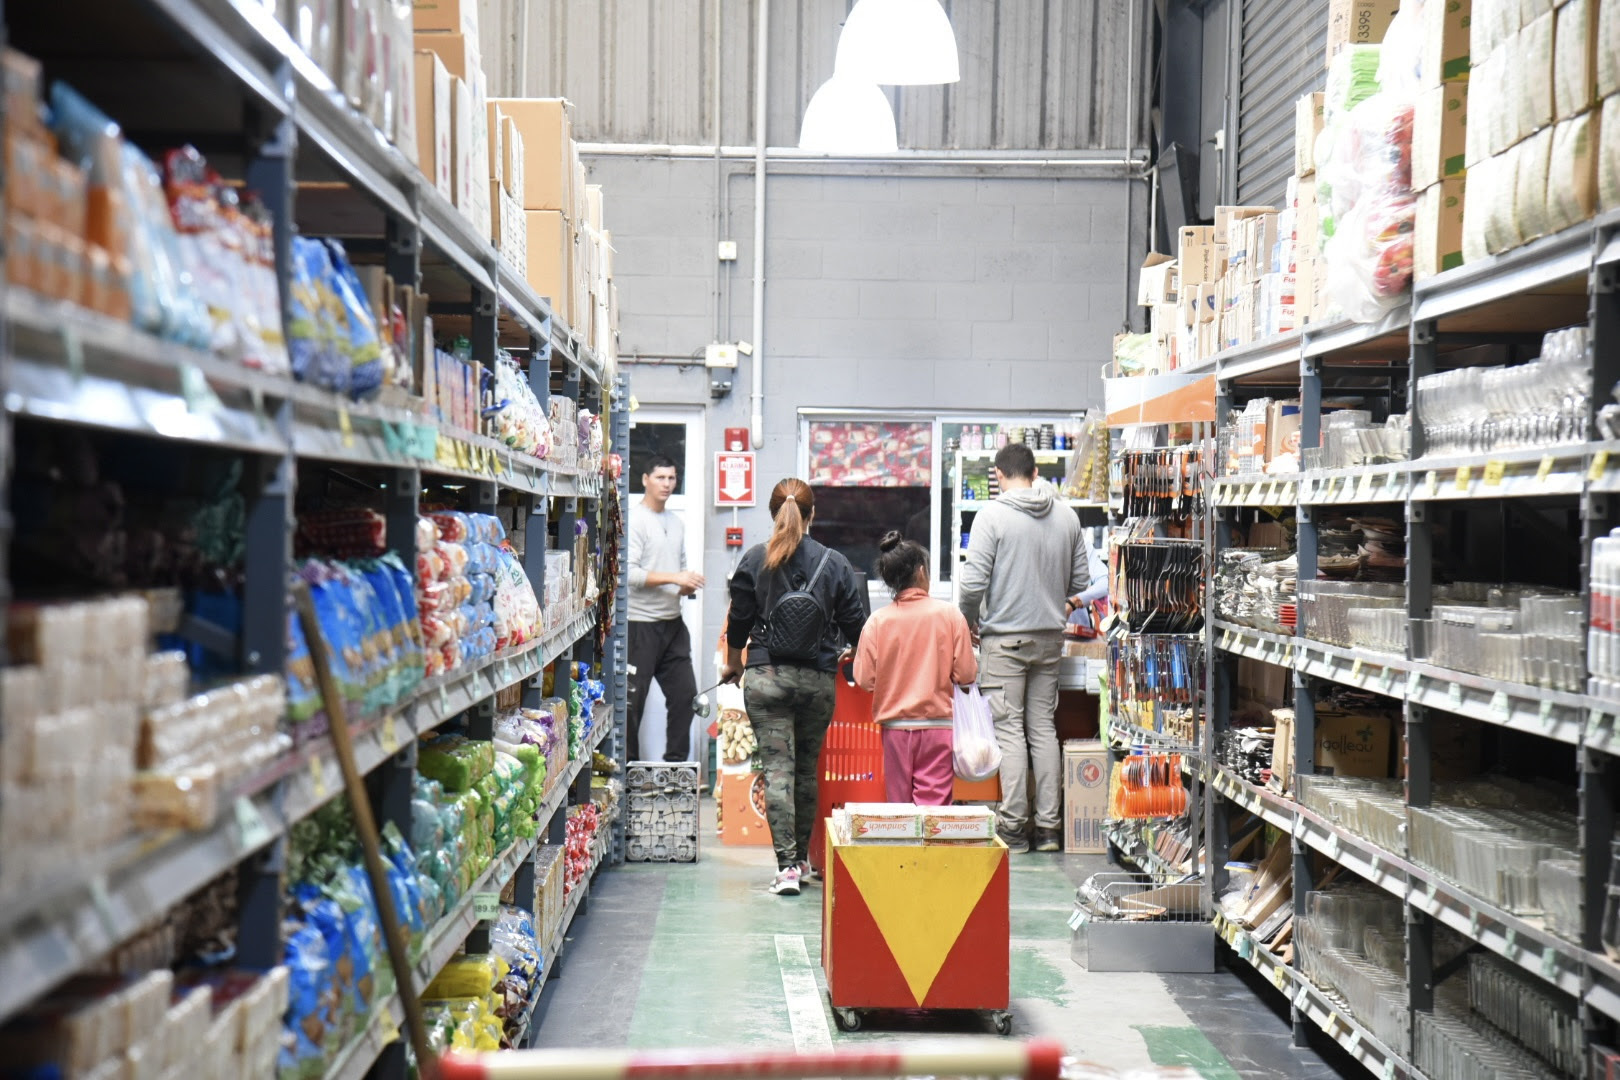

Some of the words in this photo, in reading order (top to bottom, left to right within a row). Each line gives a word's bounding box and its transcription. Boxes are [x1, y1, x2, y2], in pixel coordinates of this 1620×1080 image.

[1357, 10, 1371, 43] 13395
[868, 823, 907, 832] Sandwich
[942, 823, 980, 832] Sandwich
